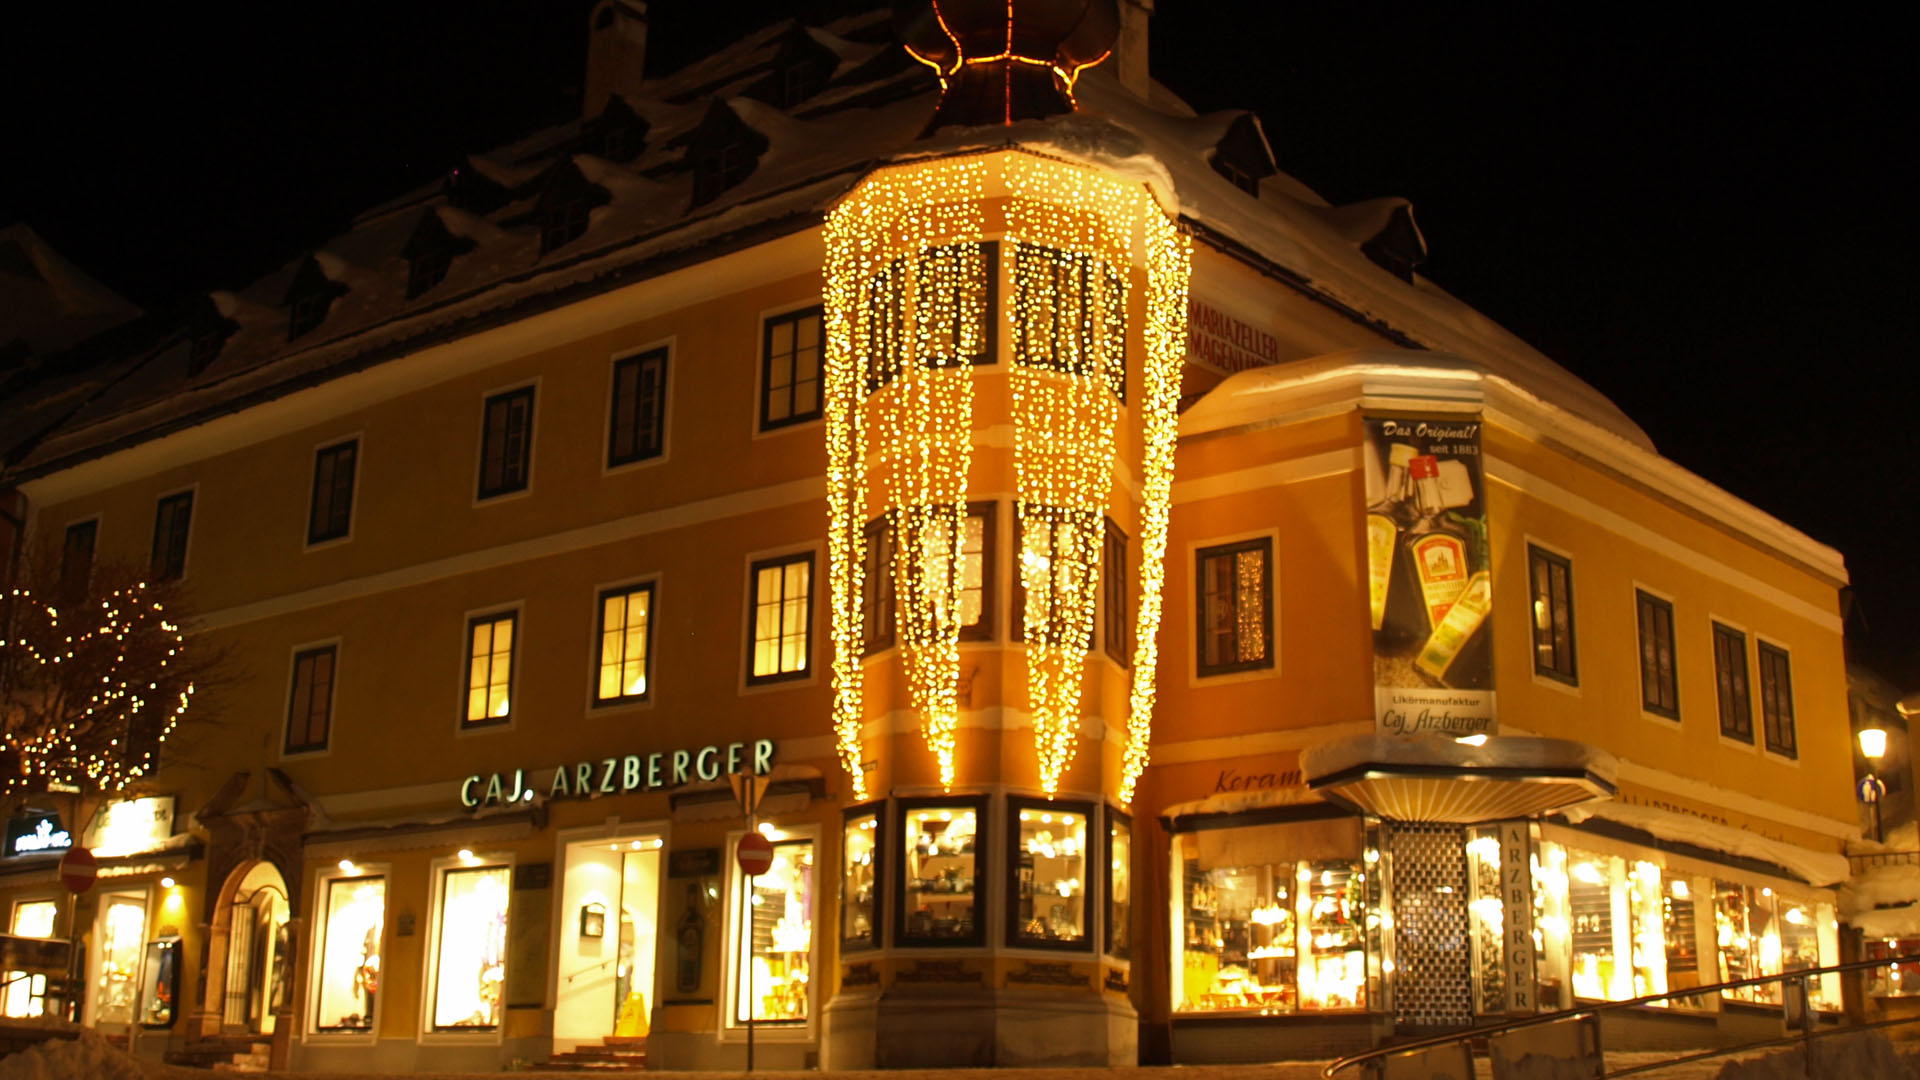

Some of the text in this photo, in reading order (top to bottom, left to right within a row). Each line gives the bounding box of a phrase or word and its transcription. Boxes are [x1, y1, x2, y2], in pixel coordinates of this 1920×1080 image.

[1383, 421, 1477, 441] Das Original!
[1429, 445, 1448, 454] seit
[1392, 696, 1480, 706] Likörmanufaktur
[1412, 708, 1490, 734] Arzberger
[461, 739, 773, 807] CAJ. ARZBERGER
[1509, 829, 1527, 1008] ARZBERGER
